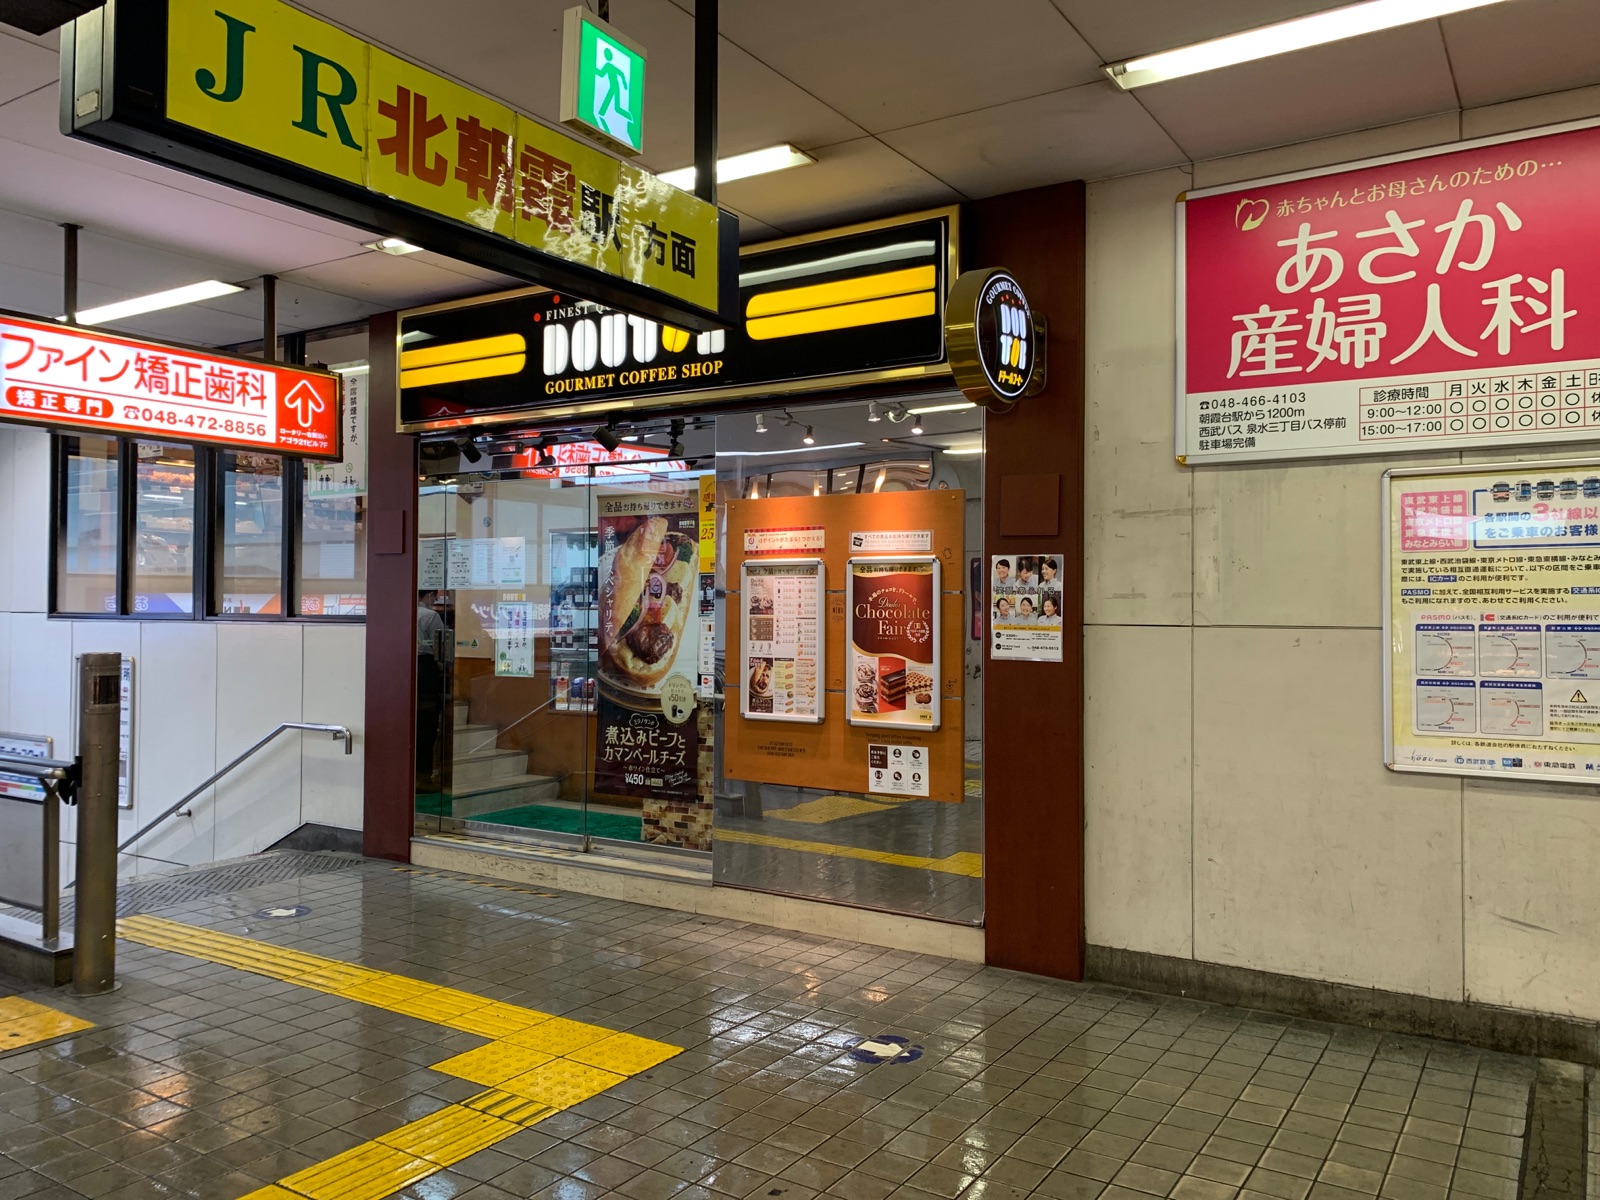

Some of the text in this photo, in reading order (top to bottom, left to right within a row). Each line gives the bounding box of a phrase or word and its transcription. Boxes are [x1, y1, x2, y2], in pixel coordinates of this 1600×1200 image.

[1275, 199, 1522, 294] あさか
[545, 305, 590, 321] FINEST
[1226, 268, 1577, 379] 産婦人科
[1, 332, 267, 410] ファイン矯正歯科
[545, 360, 724, 394] GOURMET COFFEE SHOP
[1471, 381, 1486, 395] 火
[1494, 380, 1510, 393] 水
[1517, 378, 1533, 391] 木
[1541, 376, 1557, 390] 金
[1565, 374, 1581, 388] 土
[1373, 387, 1429, 403] 診療時間
[1449, 383, 1462, 397] 月
[15, 389, 104, 417] 矯正専門
[1211, 392, 1306, 409] 048-466-4103
[143, 406, 267, 437] 048-472-8856
[1199, 408, 1305, 424] 朝霞台駅から1200m
[1199, 417, 1347, 438] 西武バス 泉水三丁目バス停前
[1199, 437, 1256, 450] 駐車場完備
[855, 603, 930, 620] Chocolate
[878, 620, 907, 636] Fair
[604, 725, 686, 749] 煮込みビーフと
[603, 746, 687, 767] カマンベールチーズ
